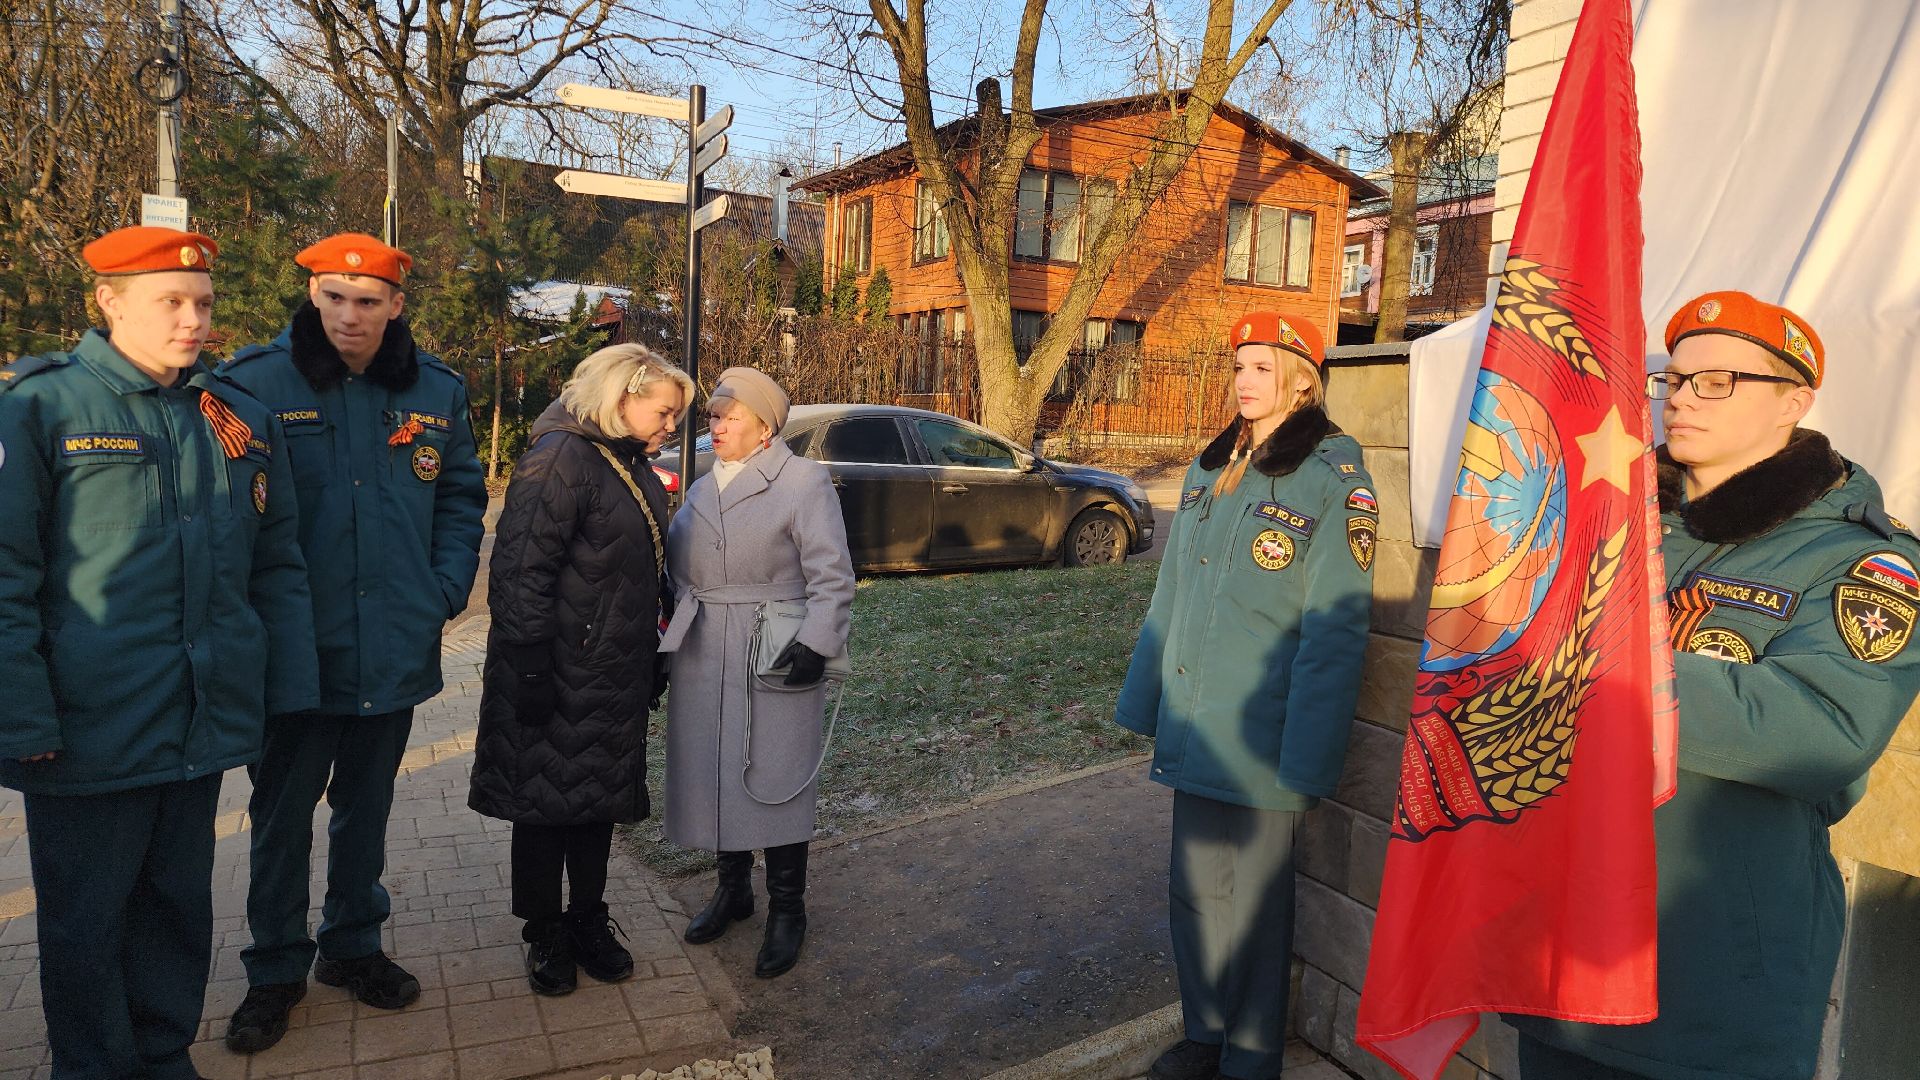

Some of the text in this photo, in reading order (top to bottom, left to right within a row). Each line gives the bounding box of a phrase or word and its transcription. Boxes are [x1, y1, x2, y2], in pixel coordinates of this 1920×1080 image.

[147, 197, 184, 208] УФАНЕТ
[146, 215, 182, 224] ИНТЕРНЕТ
[283, 410, 319, 422] РОССИИ
[65, 437, 139, 451] МЧС РОССИИ
[1873, 571, 1906, 592] RUSSIA
[1843, 588, 1913, 620] МЧС РОССИИ
[1690, 634, 1712, 650] МЧС
